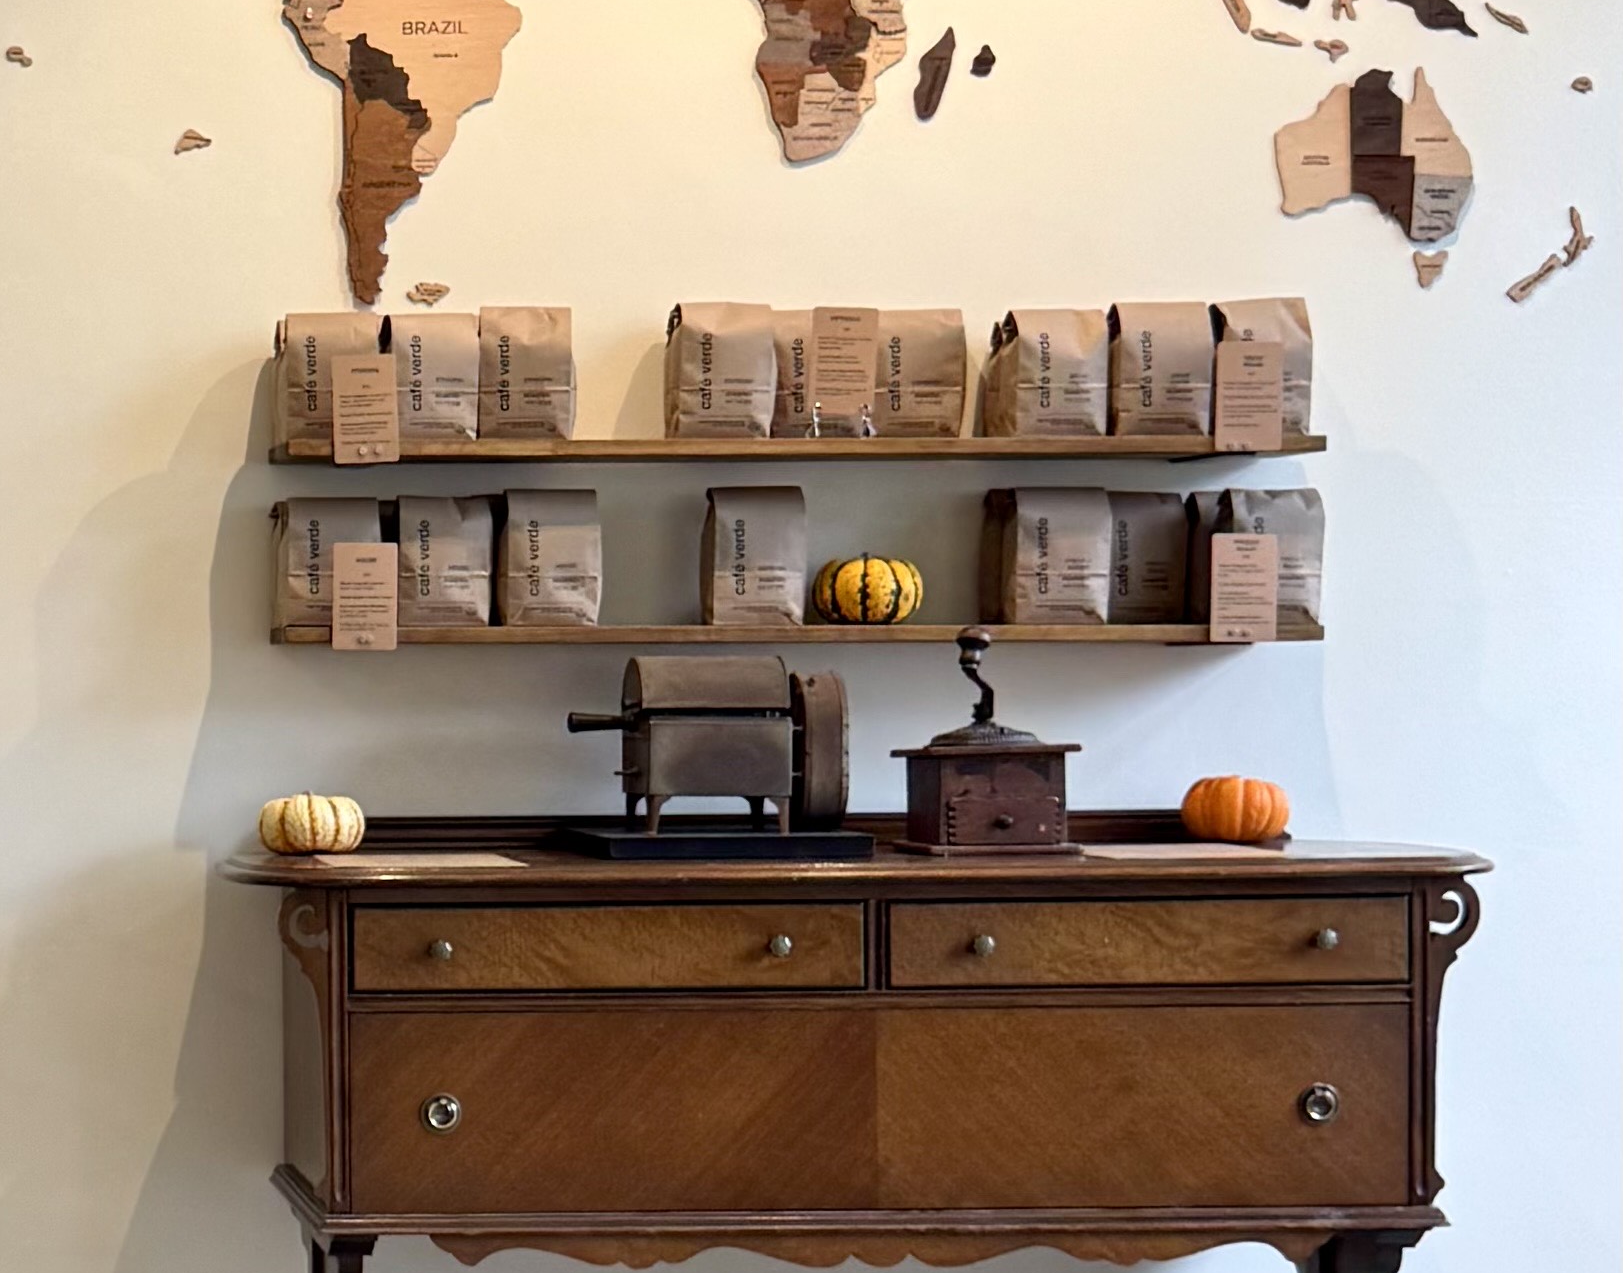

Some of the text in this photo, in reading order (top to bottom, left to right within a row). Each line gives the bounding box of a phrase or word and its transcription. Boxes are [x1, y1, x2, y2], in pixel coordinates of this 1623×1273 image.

[401, 20, 469, 36] BRAZIL
[305, 336, 316, 375] verde
[410, 336, 421, 375] verde
[498, 336, 509, 375] verde
[701, 333, 712, 373] verde
[792, 339, 803, 378] verde
[889, 337, 900, 376] verde
[1038, 333, 1049, 372] verde
[1140, 331, 1151, 370] verde
[308, 520, 319, 559] verde
[419, 520, 429, 560] verde
[528, 521, 539, 560] verde
[734, 520, 745, 560] verde
[1037, 518, 1048, 558] verde
